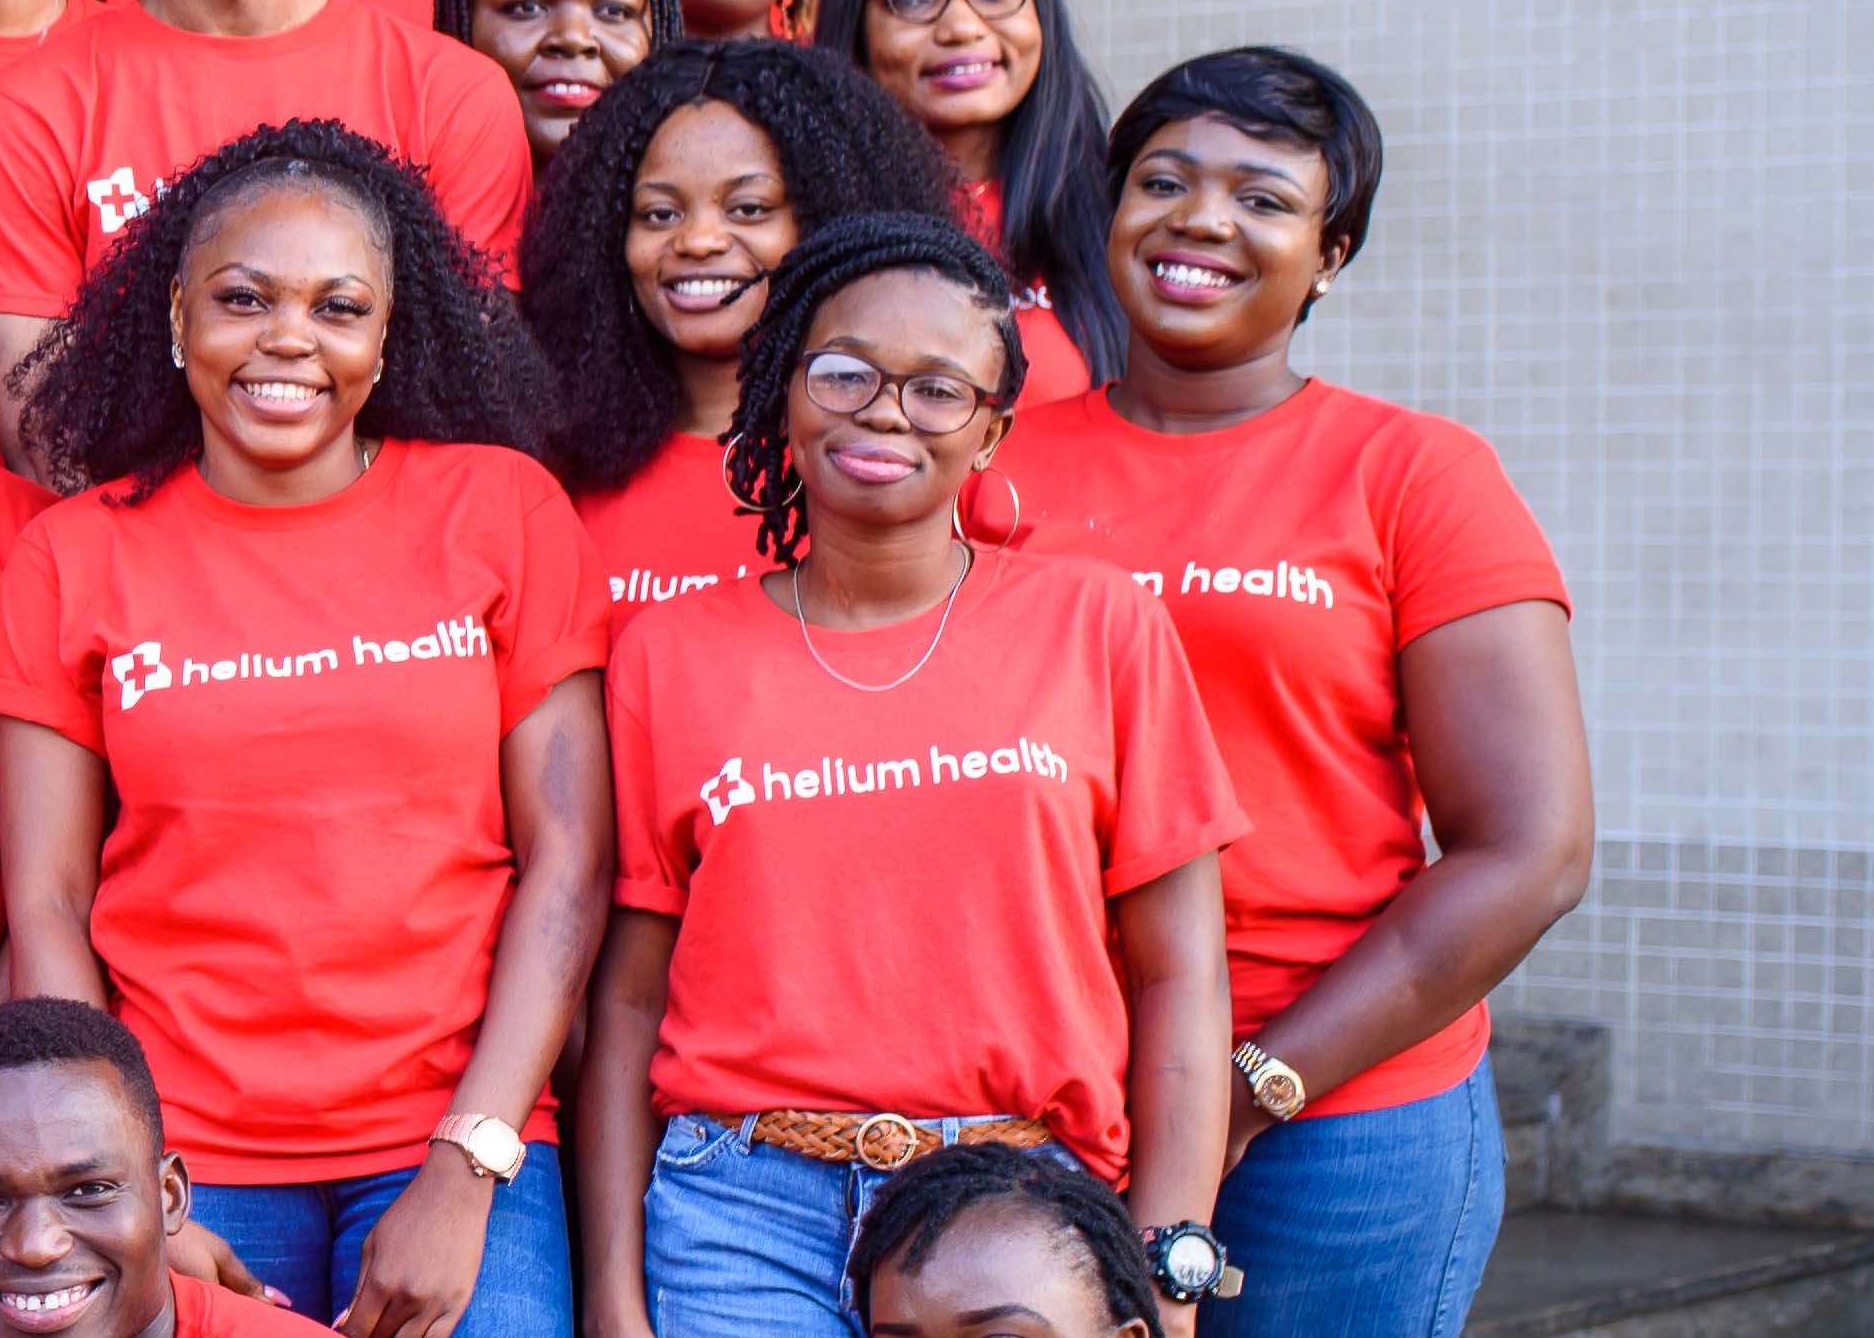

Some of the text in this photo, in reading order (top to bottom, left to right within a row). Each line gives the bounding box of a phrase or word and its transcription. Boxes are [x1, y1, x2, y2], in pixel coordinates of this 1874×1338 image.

[608, 568, 720, 603] elium
[1180, 560, 1335, 610] health
[181, 614, 489, 687] helium health
[762, 736, 1069, 802] helium health
